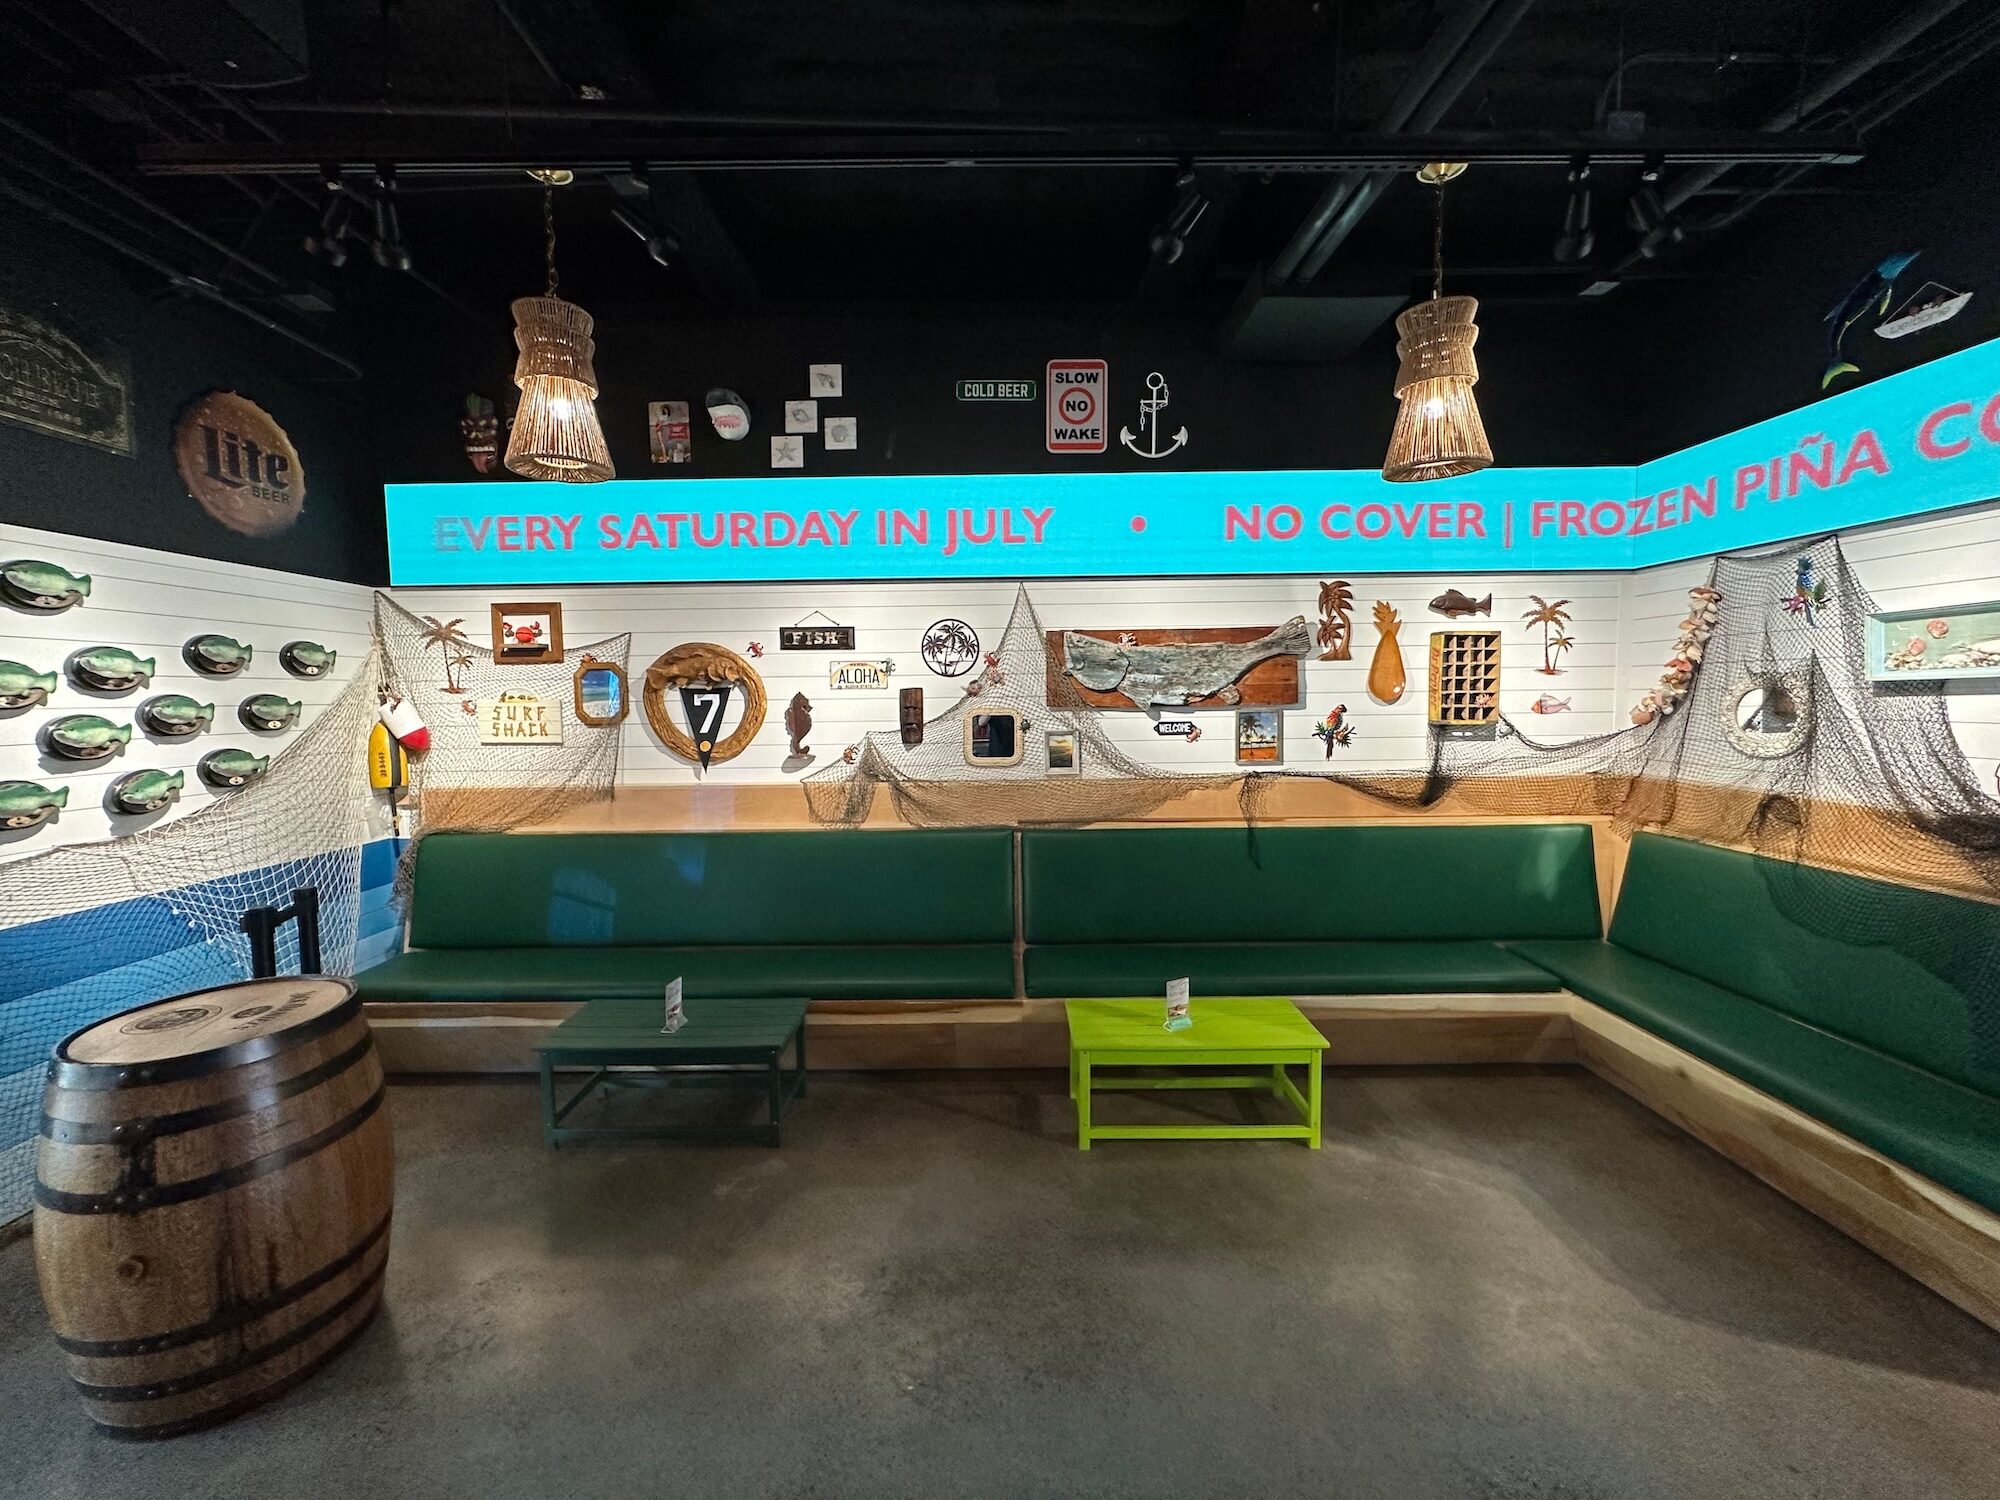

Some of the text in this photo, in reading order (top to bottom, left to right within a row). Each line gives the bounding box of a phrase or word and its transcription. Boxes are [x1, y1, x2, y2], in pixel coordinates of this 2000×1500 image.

[1055, 372, 1100, 384] SLOW
[964, 383, 1029, 398] COLD BEER
[1065, 400, 1089, 412] NO
[1054, 428, 1100, 440] WAKE
[199, 423, 289, 490] Lite
[251, 485, 291, 505] BEER
[434, 515, 583, 552] EVERY
[599, 511, 860, 551] SATURDAY
[877, 510, 929, 546] IN
[943, 508, 1054, 556] JULY
[1225, 505, 1303, 541] NO
[1320, 502, 1487, 540] COVER
[1532, 478, 1718, 538] FROZEN
[1736, 431, 1890, 511] PIÑA
[791, 631, 839, 646] FISH
[838, 668, 880, 684] ALOHA
[492, 705, 546, 721] SURF
[693, 693, 720, 734] 7
[492, 722, 548, 737] SHACK
[1159, 722, 1191, 733] WELCOME
